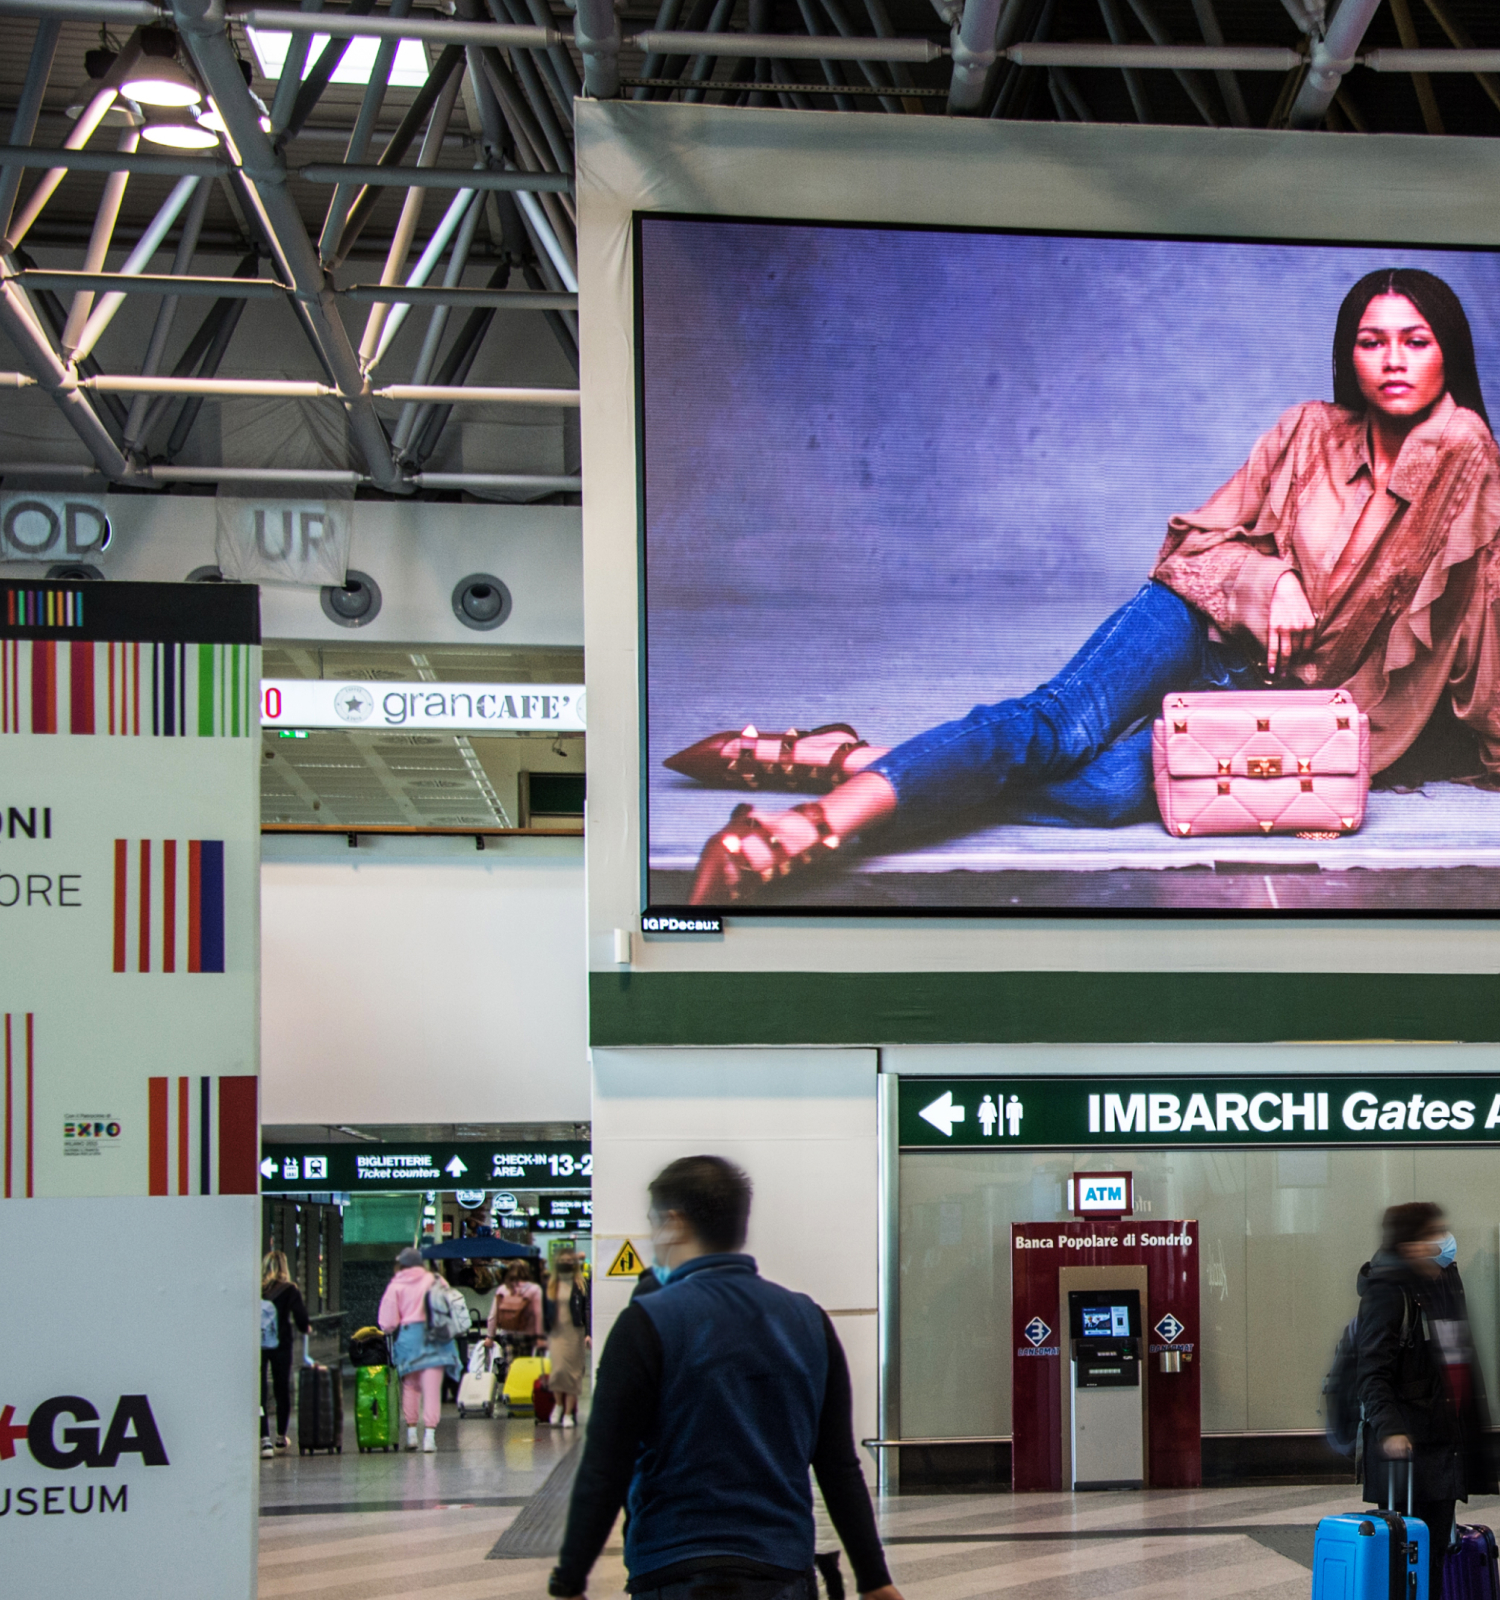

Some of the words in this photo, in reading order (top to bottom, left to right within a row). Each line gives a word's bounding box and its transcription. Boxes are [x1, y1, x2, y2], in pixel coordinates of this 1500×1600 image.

[0, 808, 51, 838] NI
[643, 918, 719, 930] IGPDecaux
[1088, 1092, 1329, 1132] IMBARCHI
[1342, 1091, 1476, 1130] Gates
[64, 1122, 121, 1137] EXPO
[357, 1155, 432, 1167] BIGLIETTERIE
[493, 1155, 547, 1165] CHECK-IN
[358, 1168, 391, 1178] Ticket
[392, 1168, 440, 1178] counters
[493, 1167, 525, 1177] AREA
[1085, 1187, 1121, 1201] ATM
[1015, 1236, 1053, 1249] Banca
[1058, 1234, 1118, 1250] Popolare
[1123, 1234, 1135, 1246] di
[1140, 1233, 1192, 1246] Sondrio
